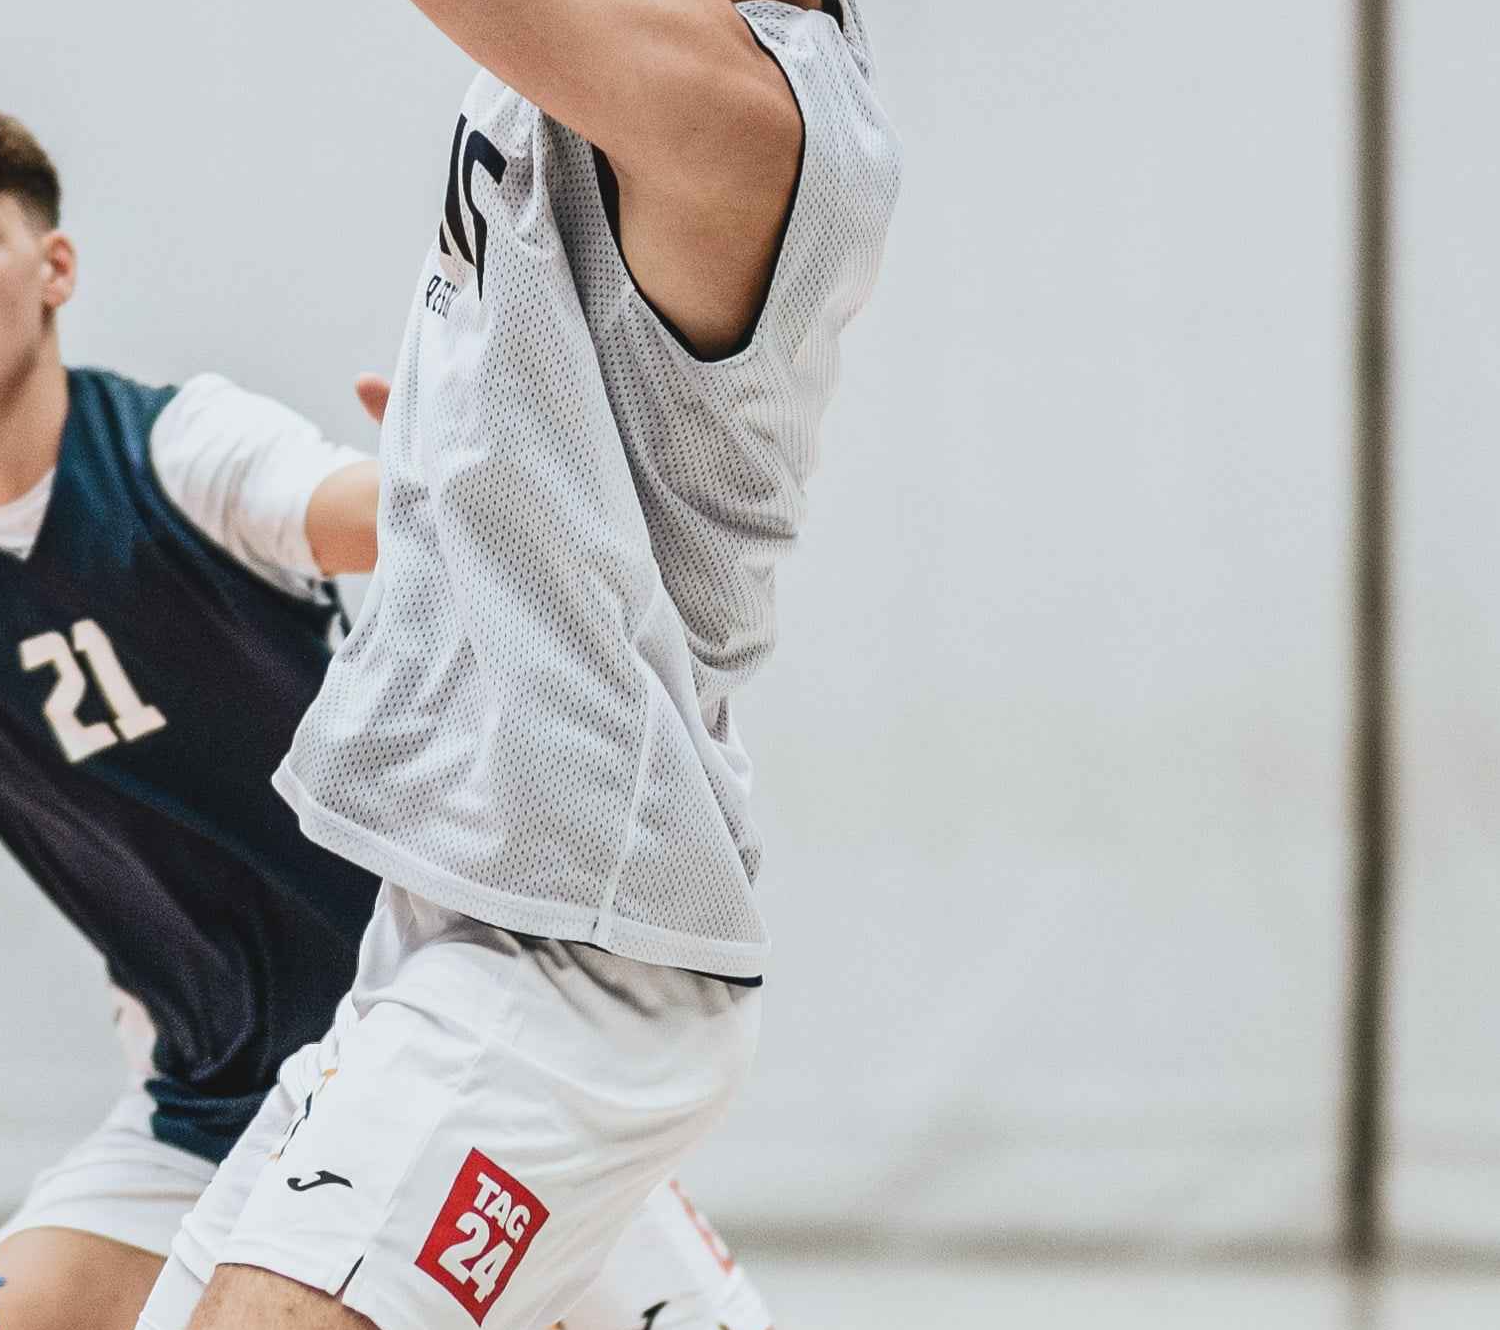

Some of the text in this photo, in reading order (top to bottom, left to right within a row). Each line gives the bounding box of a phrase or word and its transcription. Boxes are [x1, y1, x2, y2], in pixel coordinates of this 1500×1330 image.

[18, 618, 168, 764] 21
[472, 1172, 532, 1244] TAG
[436, 1211, 515, 1304] 24
